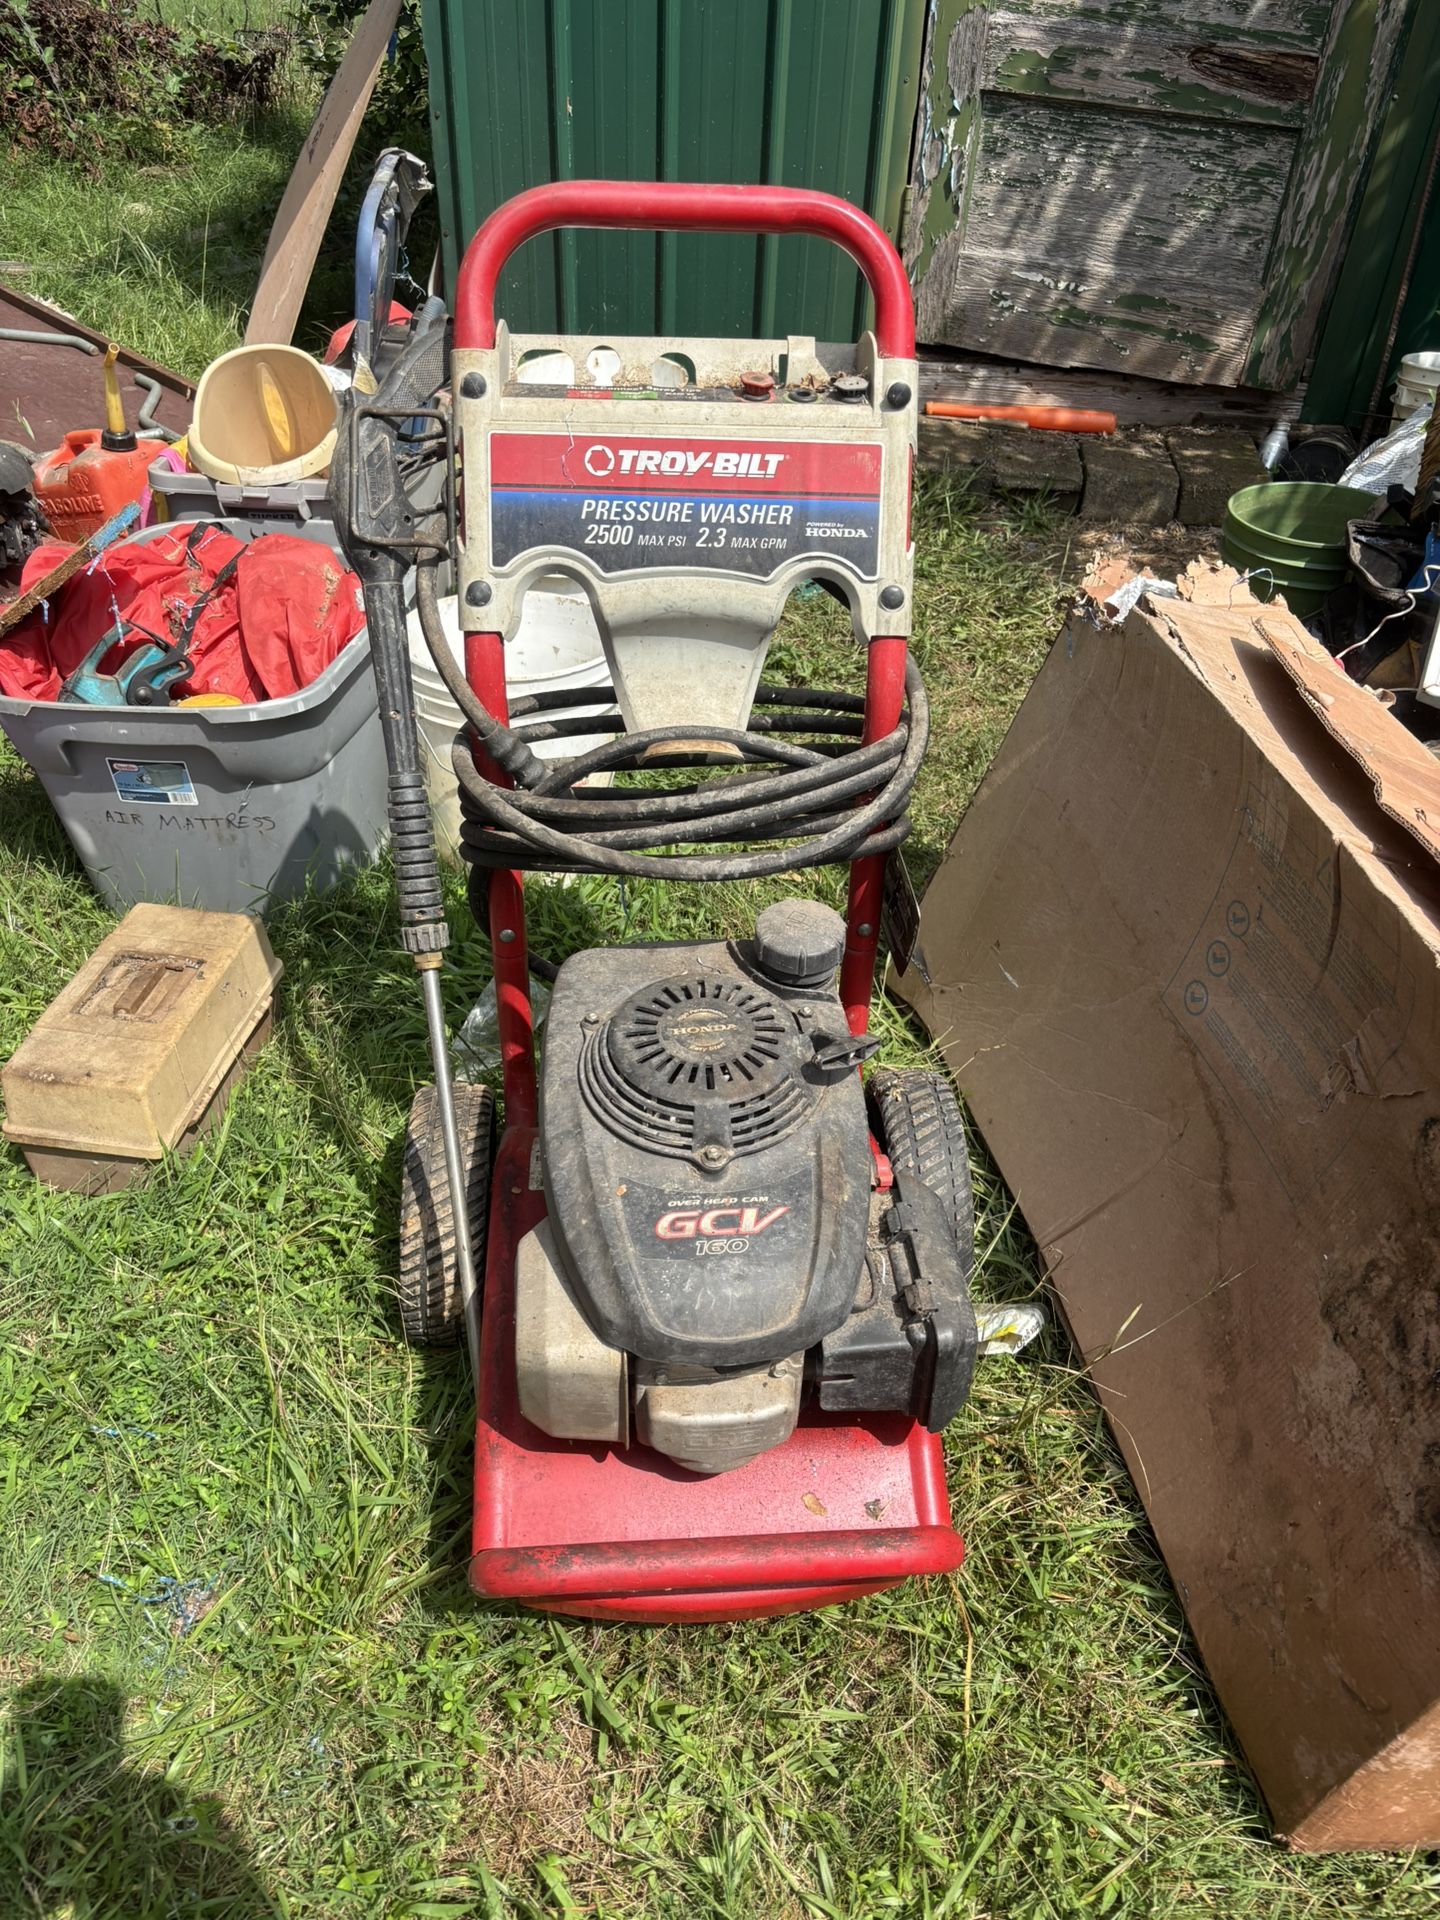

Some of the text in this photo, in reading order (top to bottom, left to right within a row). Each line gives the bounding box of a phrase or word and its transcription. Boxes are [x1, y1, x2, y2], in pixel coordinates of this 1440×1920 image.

[617, 449, 785, 478] TROY-BILT
[36, 494, 104, 517] GASOLINE
[581, 499, 794, 525] PRESSURE WASHER
[584, 524, 788, 550] 2500 MAX PSI 2.3 MAX GPM
[805, 527, 868, 538] HONDA
[105, 810, 276, 831] AIR MATTRESS
[667, 1024, 737, 1035] HONDA
[668, 1199, 700, 1207] OVER
[703, 1197, 738, 1206] HEAD
[655, 1206, 791, 1239] GCV
[696, 1238, 749, 1256] 160
